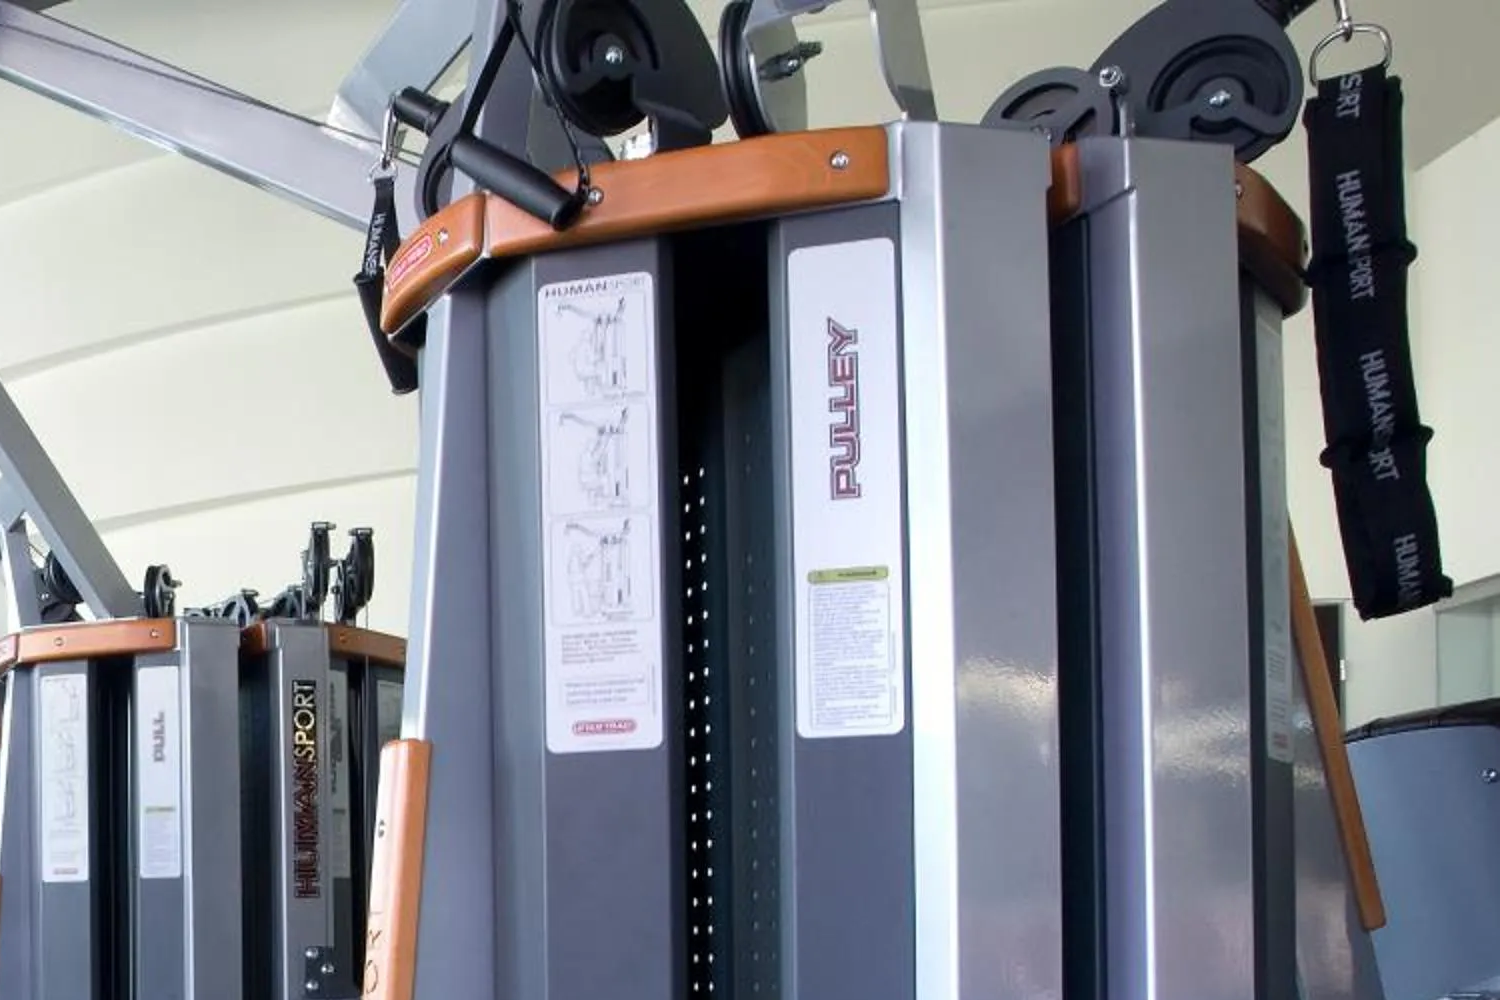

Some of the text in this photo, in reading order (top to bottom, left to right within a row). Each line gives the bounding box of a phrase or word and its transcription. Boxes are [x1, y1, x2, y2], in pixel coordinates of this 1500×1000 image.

[1335, 169, 1375, 300] HUMANPORT
[827, 316, 862, 500] PULLEY
[292, 680, 320, 898] HUMANSPORT
